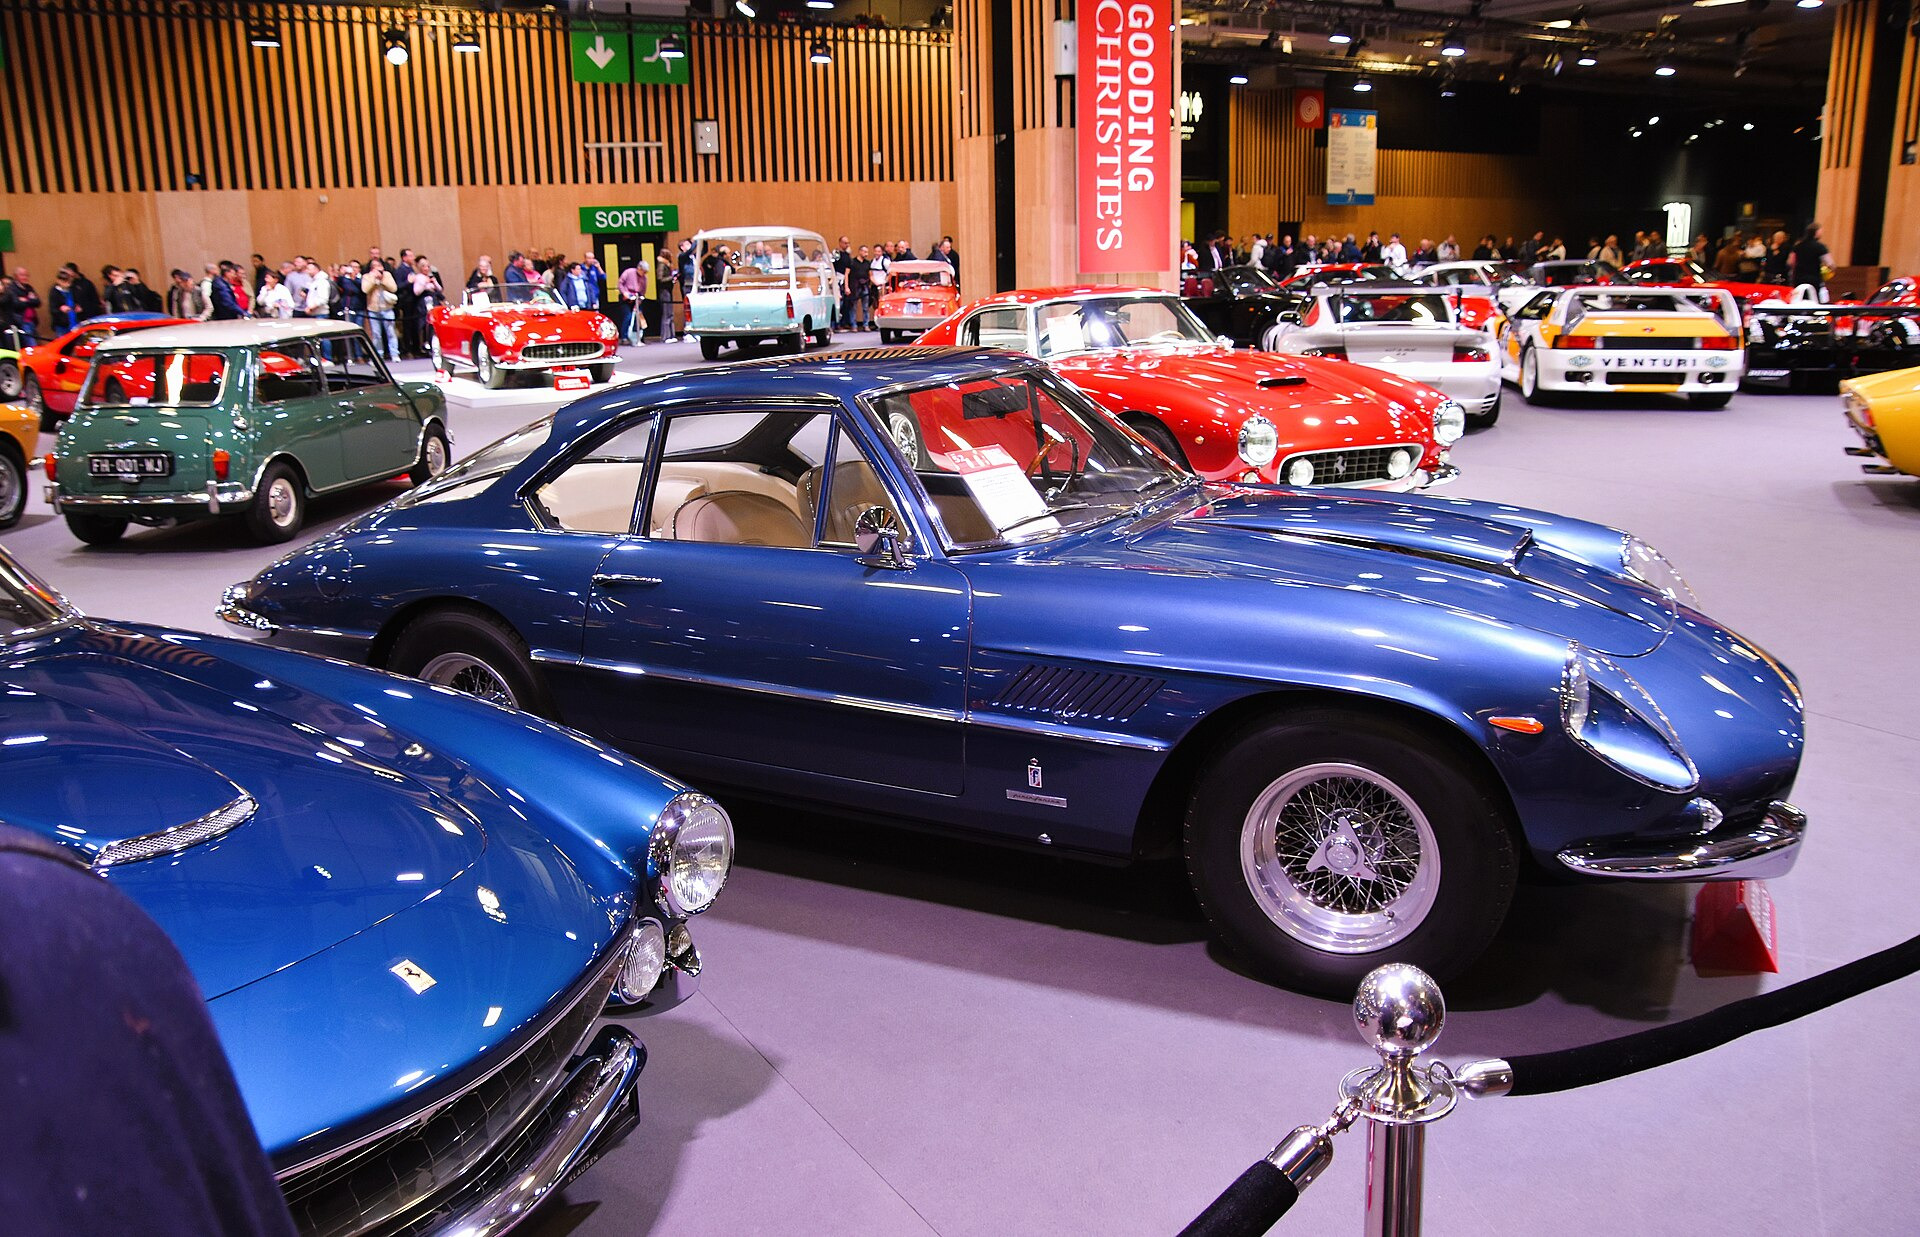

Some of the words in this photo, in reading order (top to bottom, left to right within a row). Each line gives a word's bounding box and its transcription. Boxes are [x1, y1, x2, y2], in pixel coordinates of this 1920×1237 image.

[1127, 3, 1155, 192] GOODING
[1095, 0, 1123, 251] CHRISTIE'S
[595, 210, 664, 228] SORTIE
[1602, 358, 1697, 367] VENTURI
[568, 1154, 599, 1183] KLAUSEN
